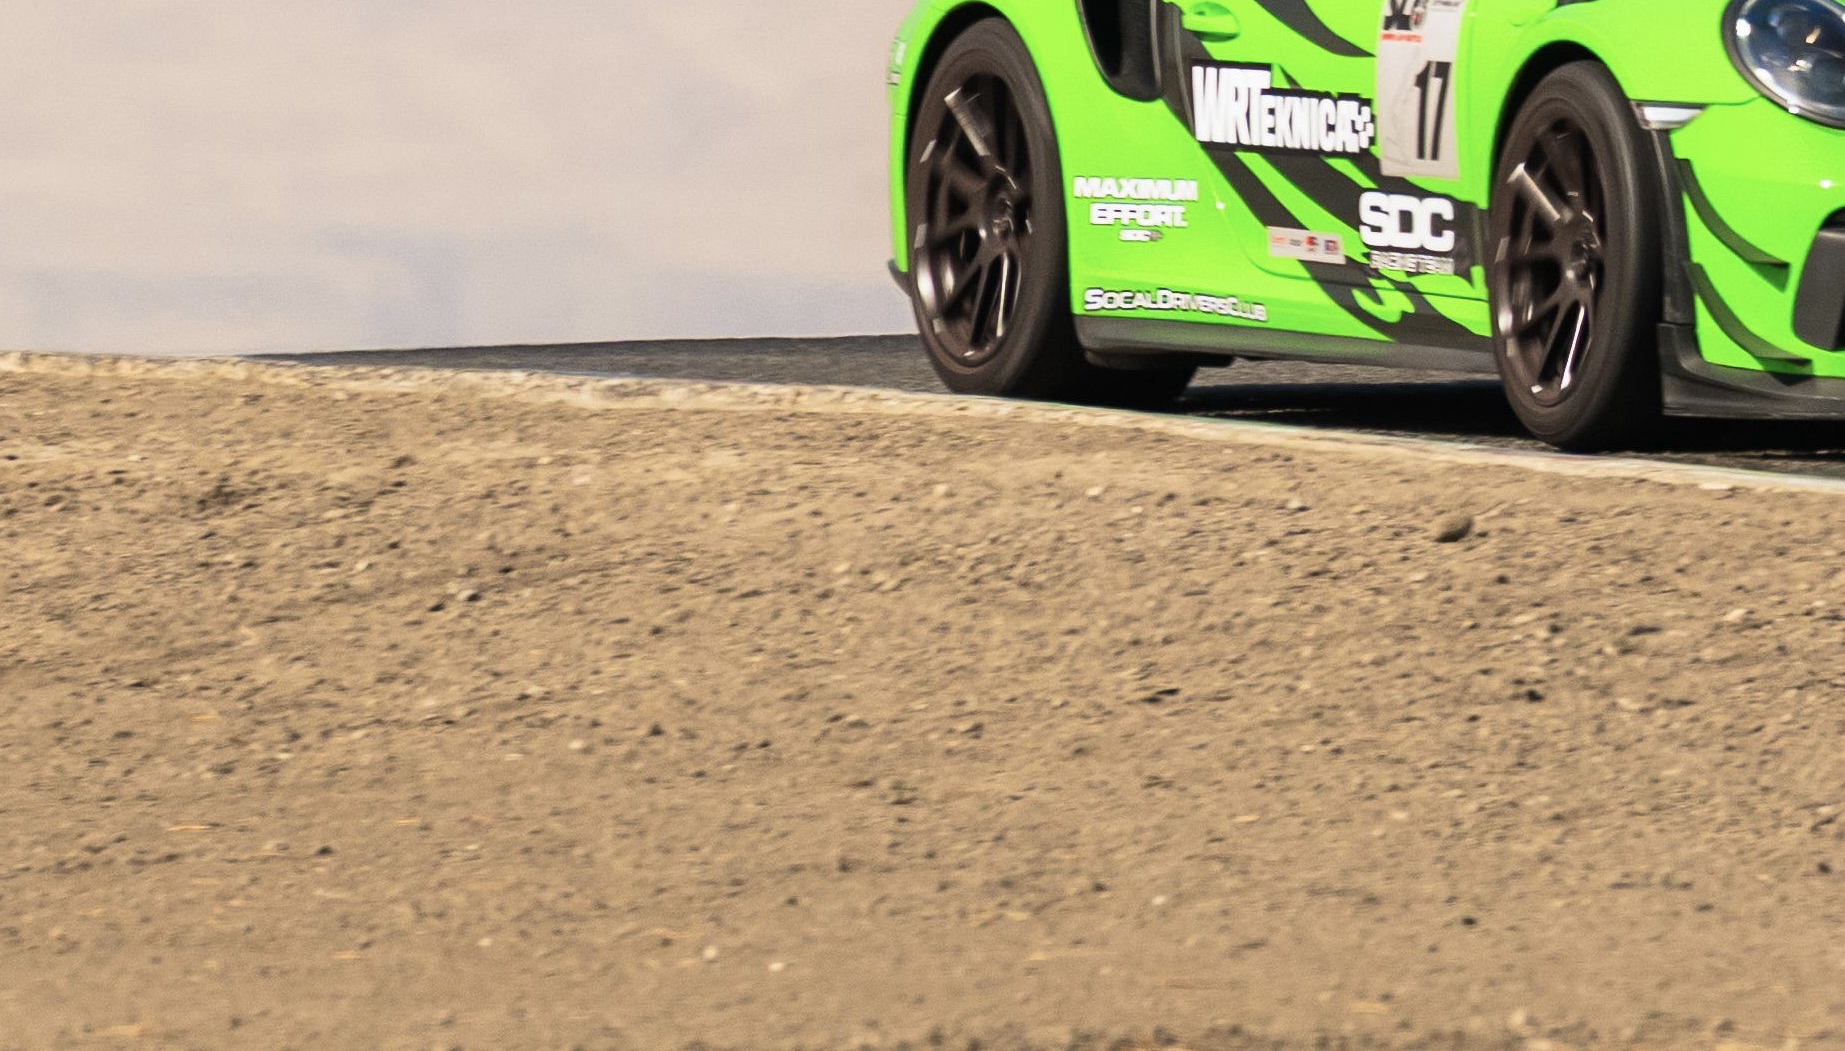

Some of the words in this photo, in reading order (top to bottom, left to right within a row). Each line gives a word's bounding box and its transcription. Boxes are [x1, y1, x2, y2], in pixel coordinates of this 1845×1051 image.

[1415, 60, 1452, 160] 17
[1073, 176, 1198, 201] MAXIMUM
[1359, 191, 1455, 252] SDC
